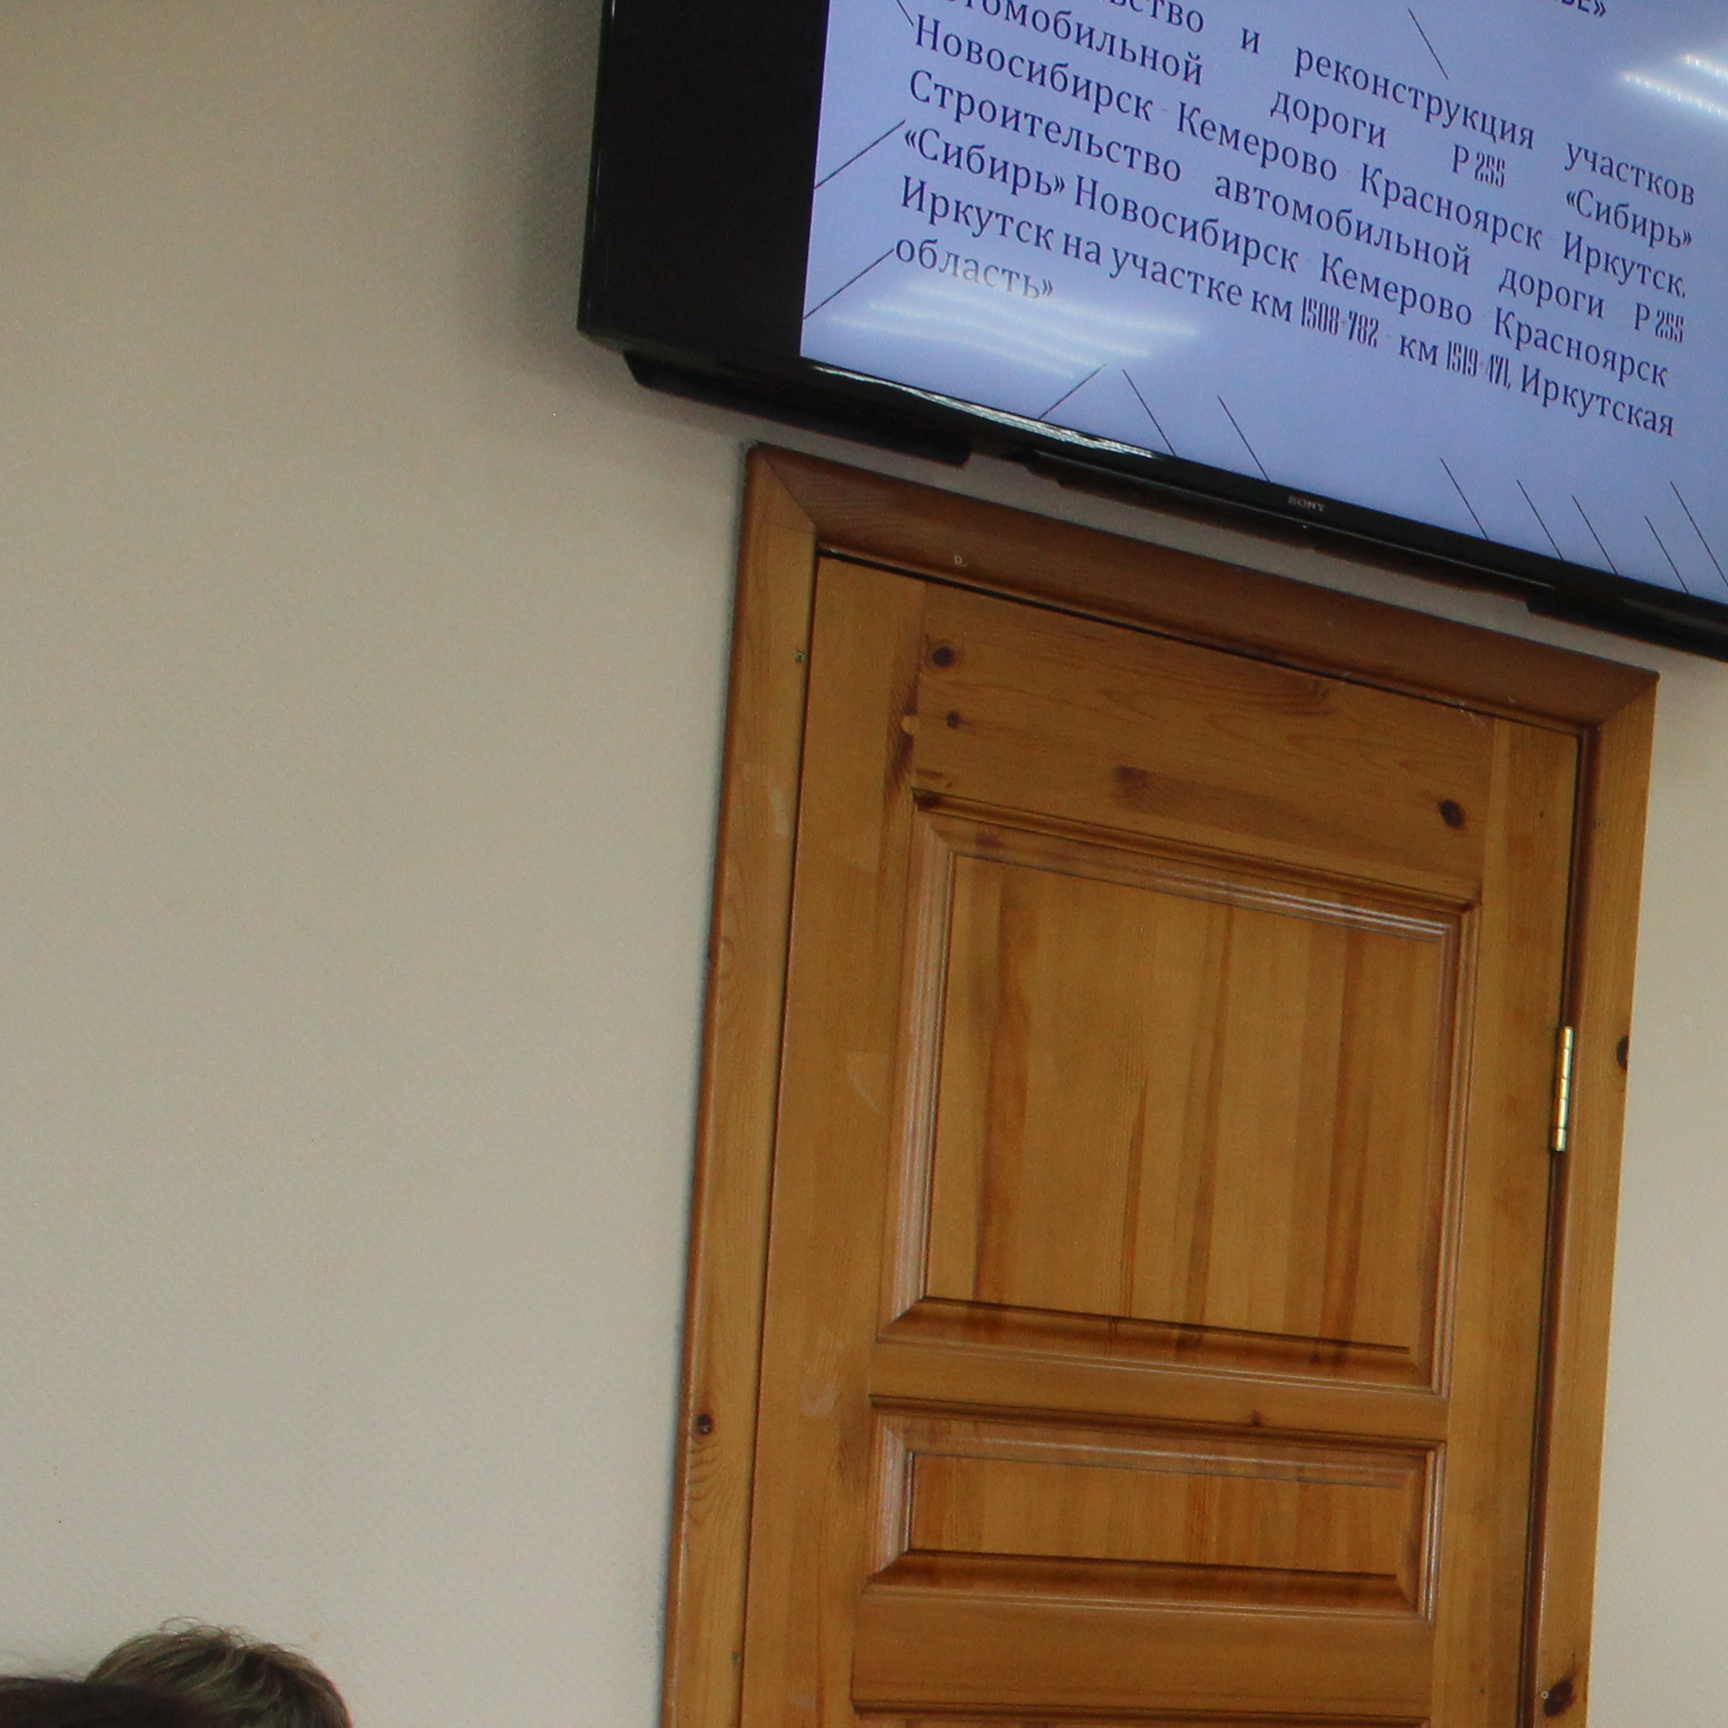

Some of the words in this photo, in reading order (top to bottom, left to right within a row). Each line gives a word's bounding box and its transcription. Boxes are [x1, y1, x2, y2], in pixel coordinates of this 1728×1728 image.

[910, 70, 1182, 182] Строительство
[1215, 176, 1471, 276] автомобильной
[1498, 267, 1605, 320] дороги
[915, 13, 1153, 122] Новосибирск
[1177, 102, 1338, 182] Кемерово
[1360, 162, 1543, 250] Красноярск
[1562, 231, 1687, 299] Иркутск.
[1241, 28, 1262, 55] и
[1294, 46, 1535, 151] реконструкция
[1564, 142, 1695, 206] участков
[1270, 91, 1387, 149] дороги
[1566, 189, 1693, 248] «Сибирь»
[895, 238, 1054, 300] область»
[901, 175, 1053, 251] Иркутск
[1063, 232, 1101, 265] на
[1109, 247, 1244, 307] участке
[1252, 290, 1293, 323] км
[1399, 334, 1438, 366] км
[1521, 363, 1674, 437] Иркутская
[905, 127, 1066, 197] «Сибирь»
[1075, 175, 1299, 273] Новосибирск
[1320, 252, 1472, 326] Кемерово
[1494, 307, 1669, 388] Красноярск
